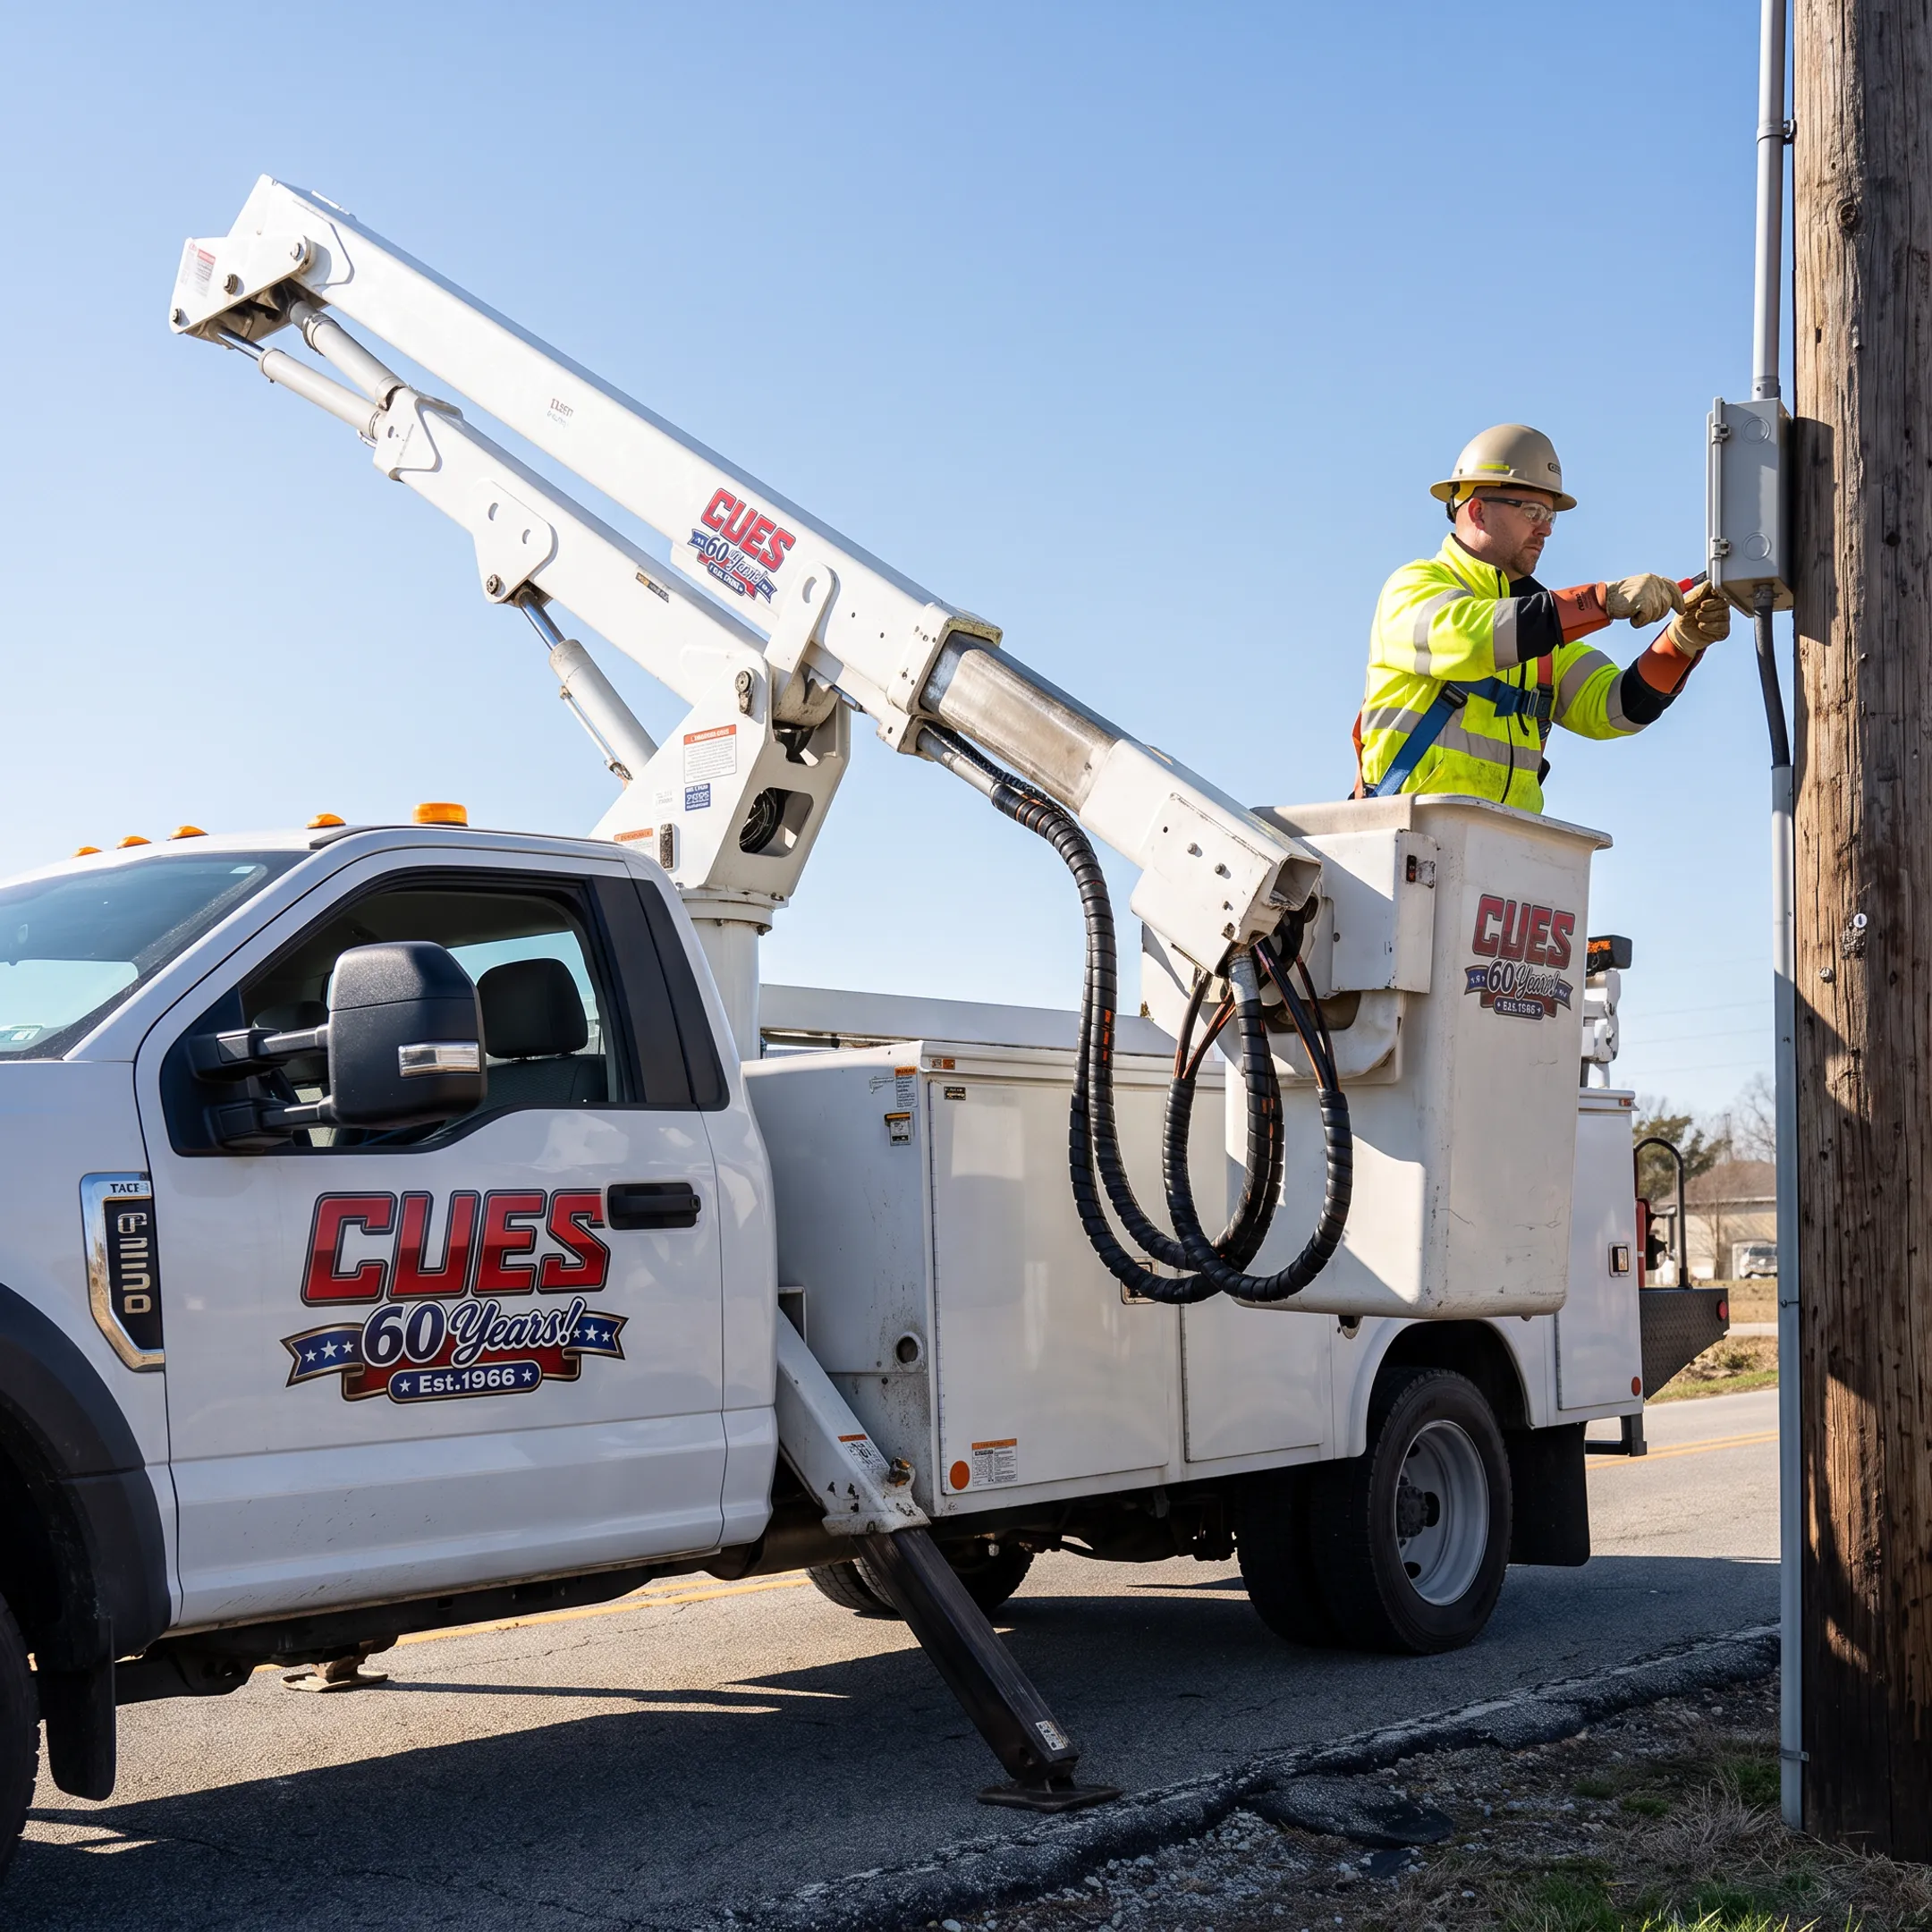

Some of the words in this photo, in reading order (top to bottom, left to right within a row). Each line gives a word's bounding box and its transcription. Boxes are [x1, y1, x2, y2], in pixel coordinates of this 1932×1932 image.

[701, 487, 796, 573] CUES
[704, 534, 730, 564] 60
[1472, 894, 1575, 970] CUES
[1487, 958, 1516, 995] 60
[301, 1188, 612, 1308] CUES
[361, 1300, 448, 1368] 60
[447, 1295, 588, 1369] Years!
[419, 1368, 516, 1394] Est.1966
